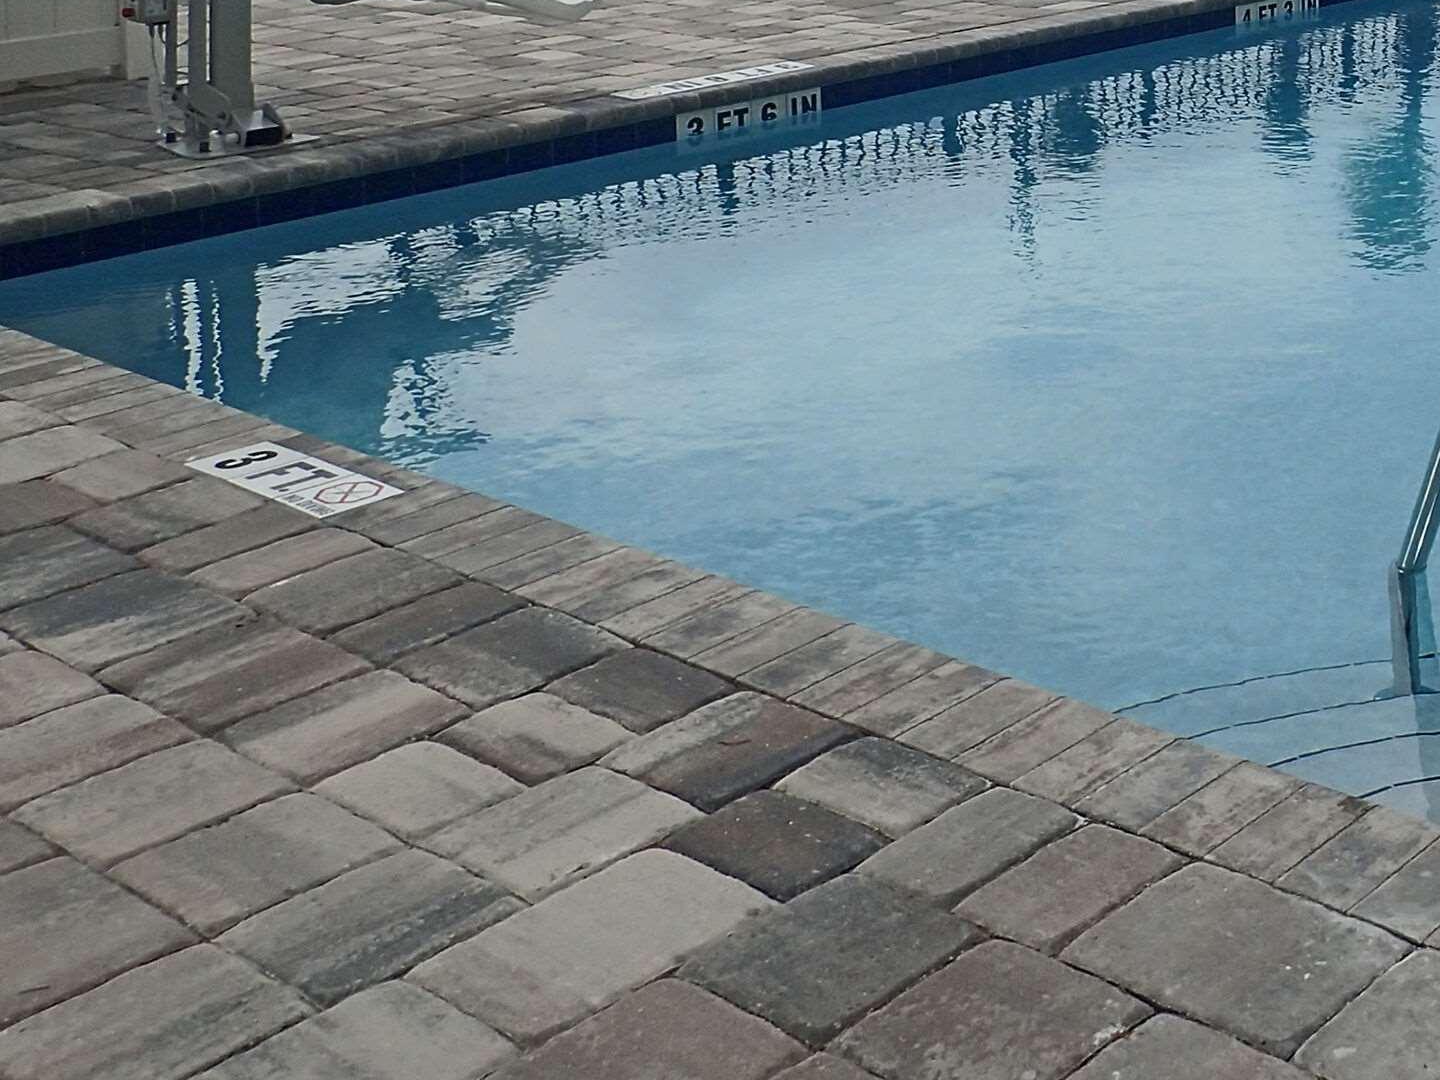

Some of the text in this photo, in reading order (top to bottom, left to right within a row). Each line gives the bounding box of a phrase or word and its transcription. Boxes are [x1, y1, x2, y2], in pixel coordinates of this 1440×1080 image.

[717, 107, 749, 131] FT
[761, 102, 777, 121] 6
[791, 93, 817, 116] IN
[214, 450, 339, 493] 3 FT.
